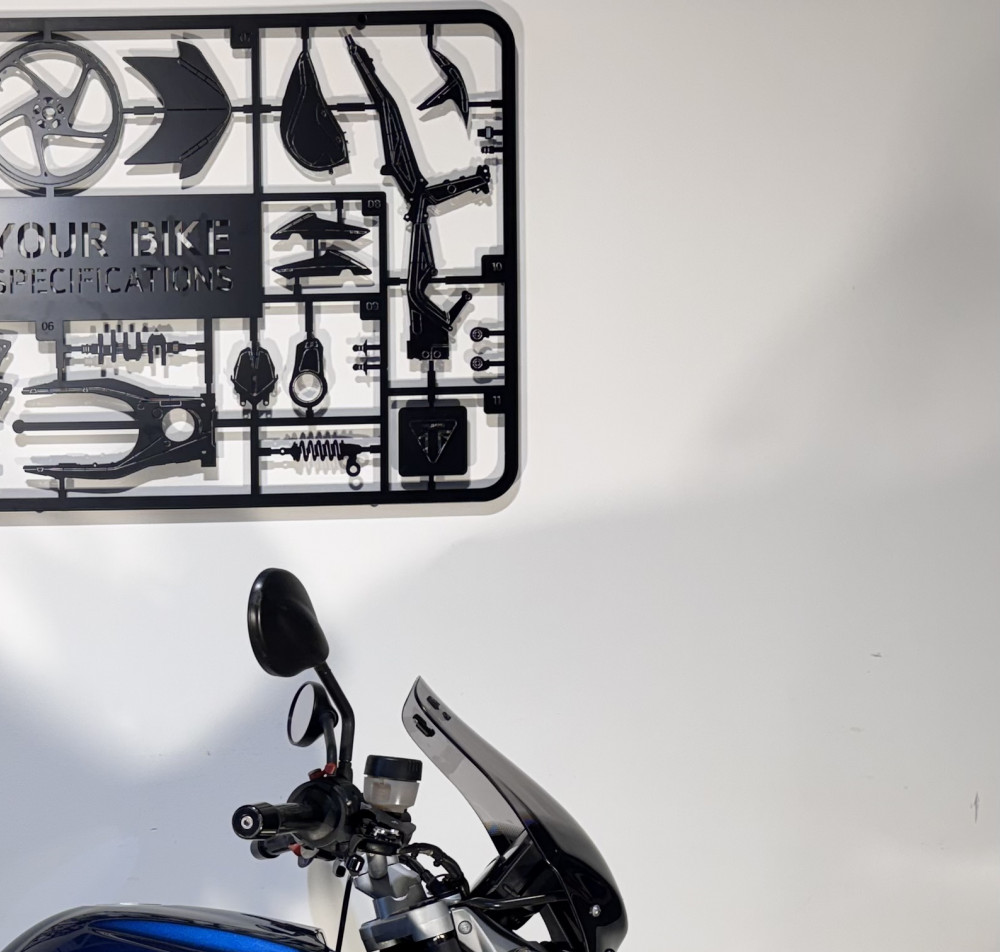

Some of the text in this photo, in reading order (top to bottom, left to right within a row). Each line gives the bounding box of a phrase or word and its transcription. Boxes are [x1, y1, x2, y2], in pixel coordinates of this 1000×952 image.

[131, 219, 232, 257] BIKE
[491, 262, 503, 272] 10
[41, 321, 55, 331] 06
[492, 395, 502, 405] 11
